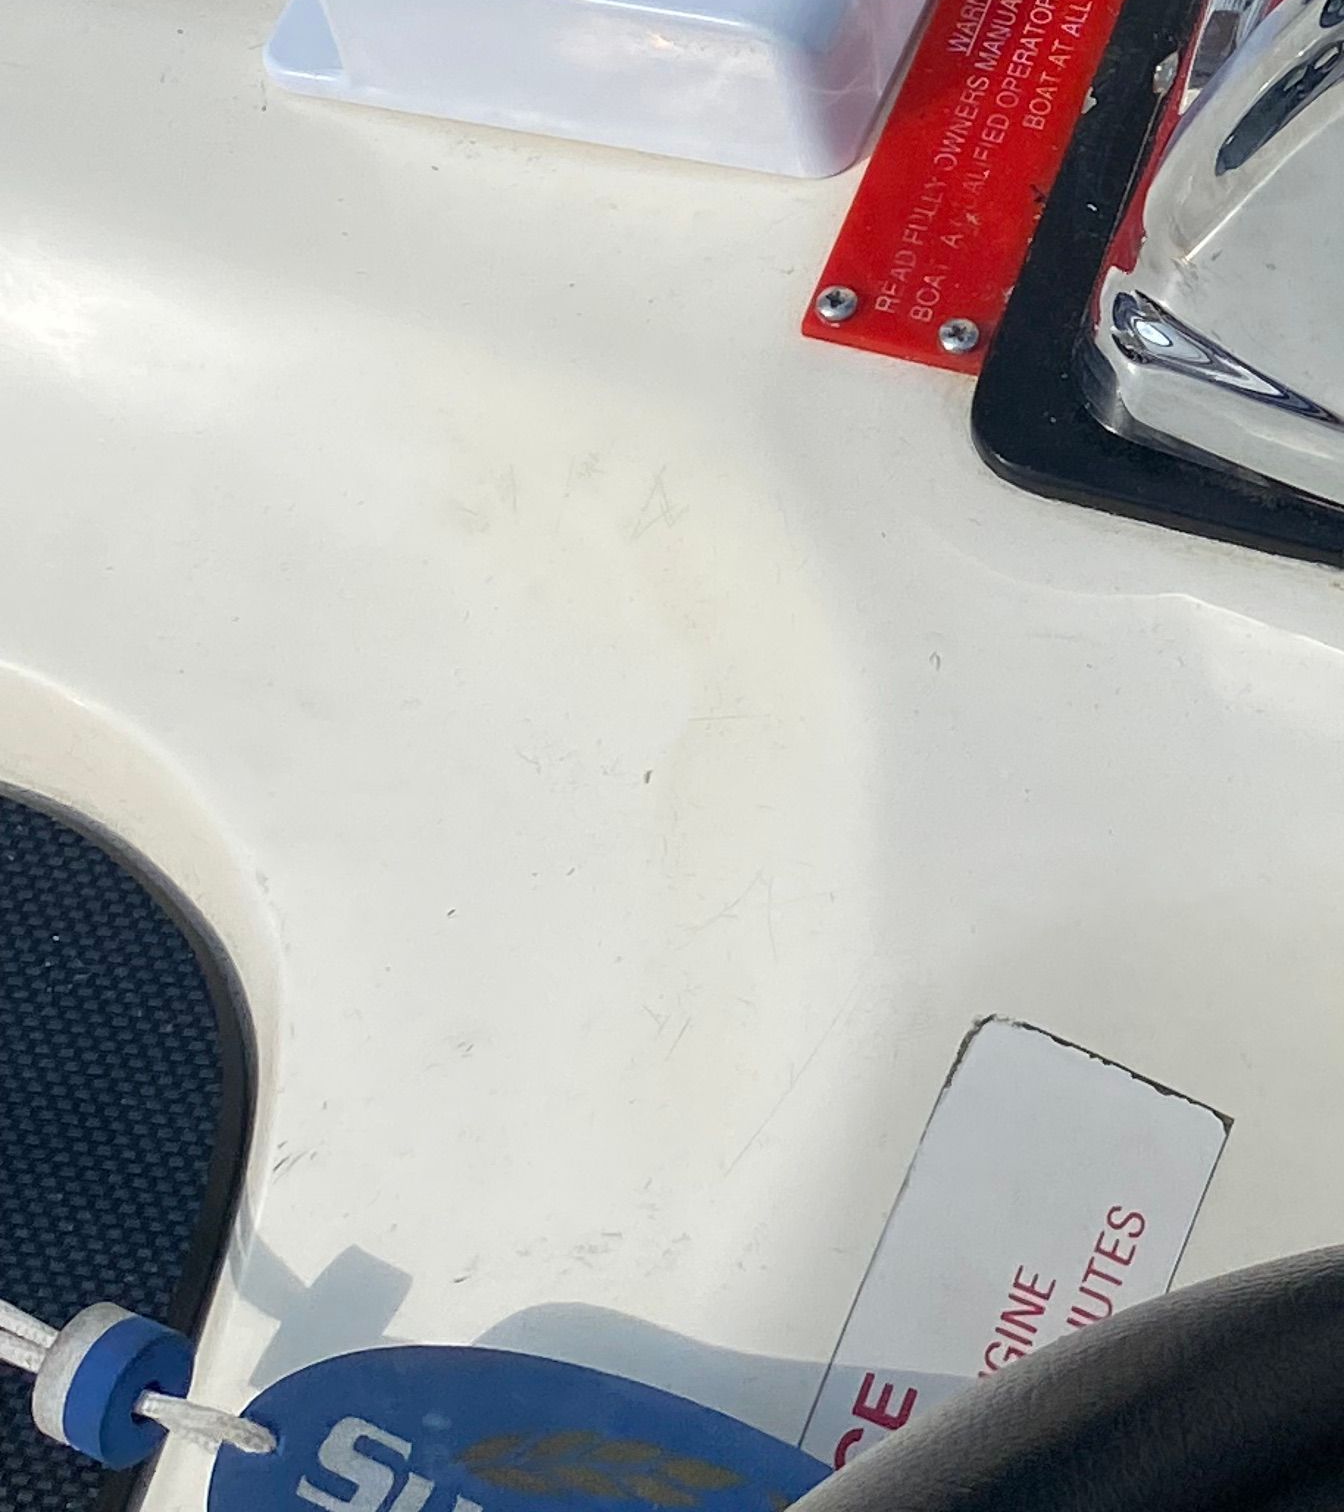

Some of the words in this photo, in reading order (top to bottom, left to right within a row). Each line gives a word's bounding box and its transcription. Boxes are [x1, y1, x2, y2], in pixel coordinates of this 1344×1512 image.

[1023, 72, 1061, 128] BOAT
[1048, 41, 1073, 66] AT
[875, 248, 917, 312] READ
[934, 74, 988, 169] OWNERS
[948, 112, 1010, 224] UALIFIED
[939, 230, 962, 246] A
[978, 1264, 1056, 1378] GINE
